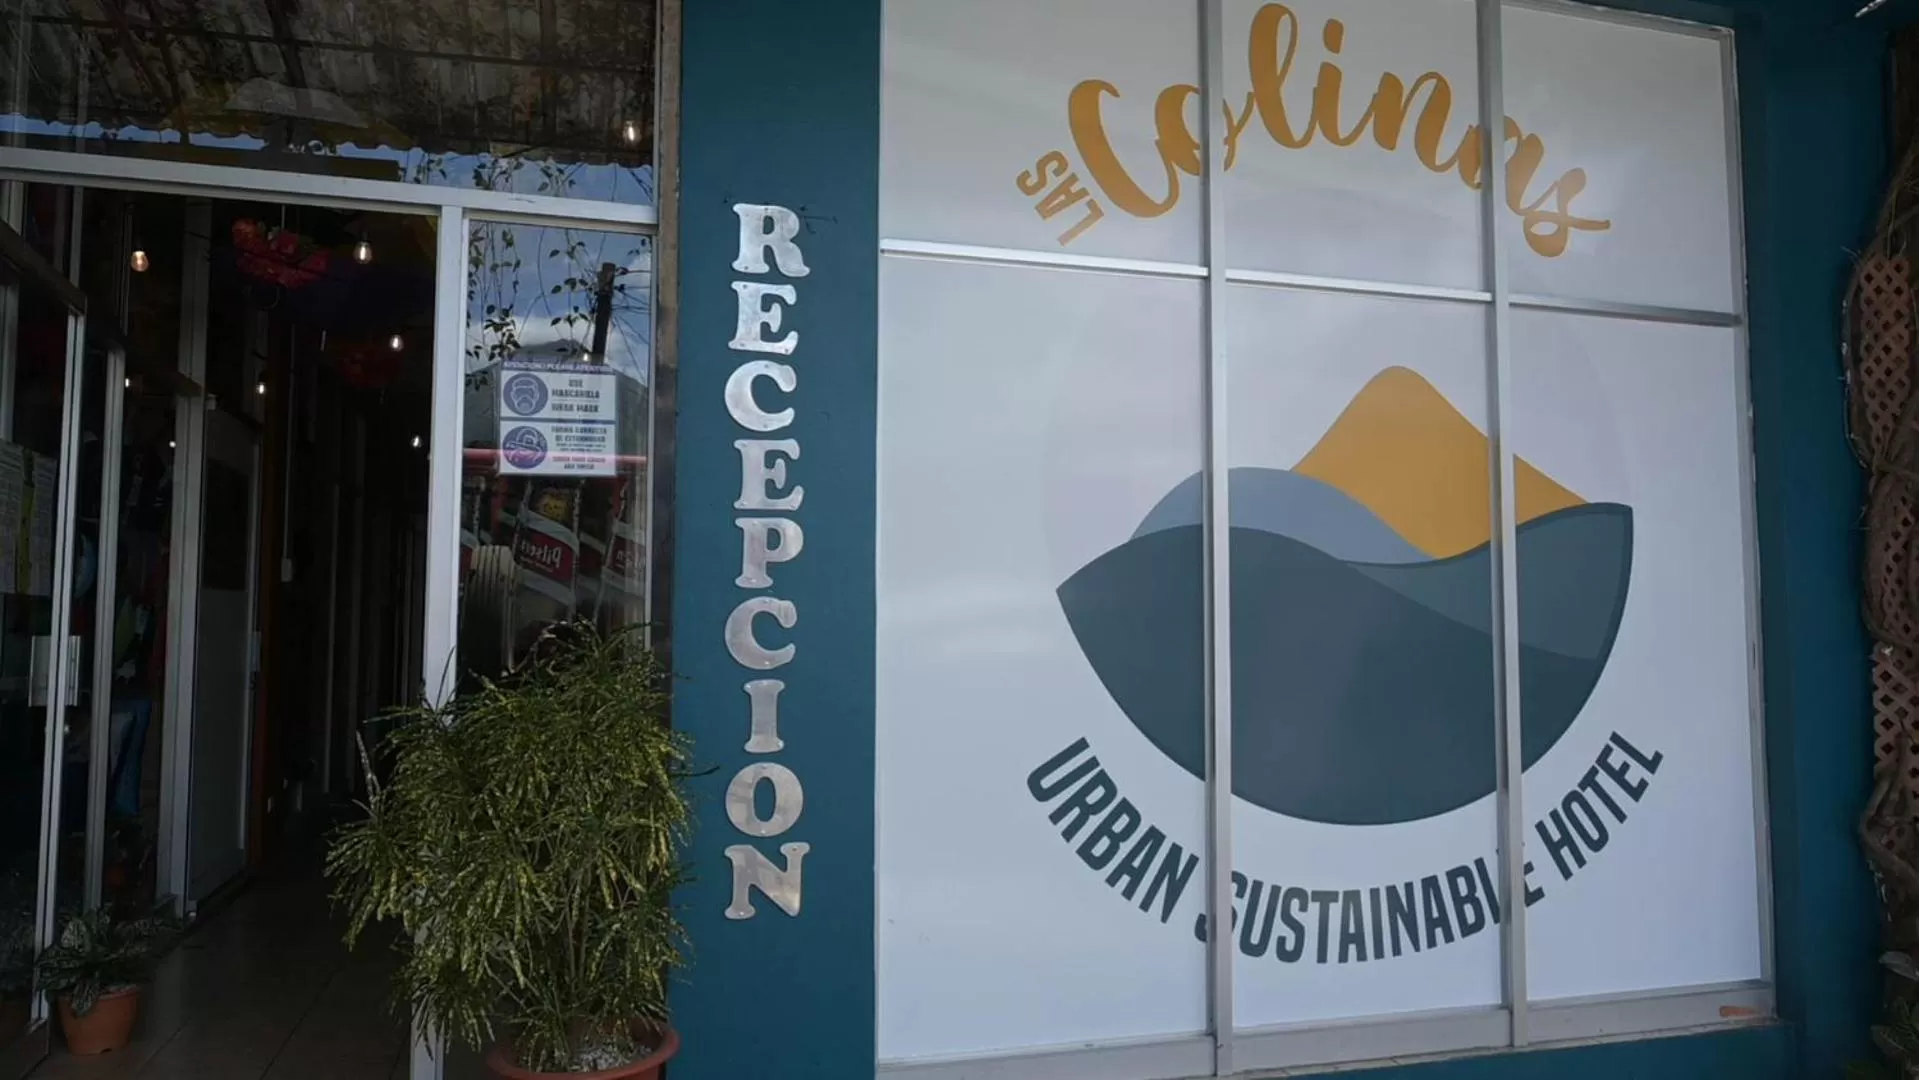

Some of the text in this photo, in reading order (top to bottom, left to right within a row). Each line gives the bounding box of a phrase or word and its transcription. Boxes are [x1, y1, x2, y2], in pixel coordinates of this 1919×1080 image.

[1016, 3, 1611, 258] LAS Colinas
[724, 203, 811, 922] RECEPCION
[1027, 737, 1199, 924] URBAN
[1534, 731, 1664, 881] HOTEL
